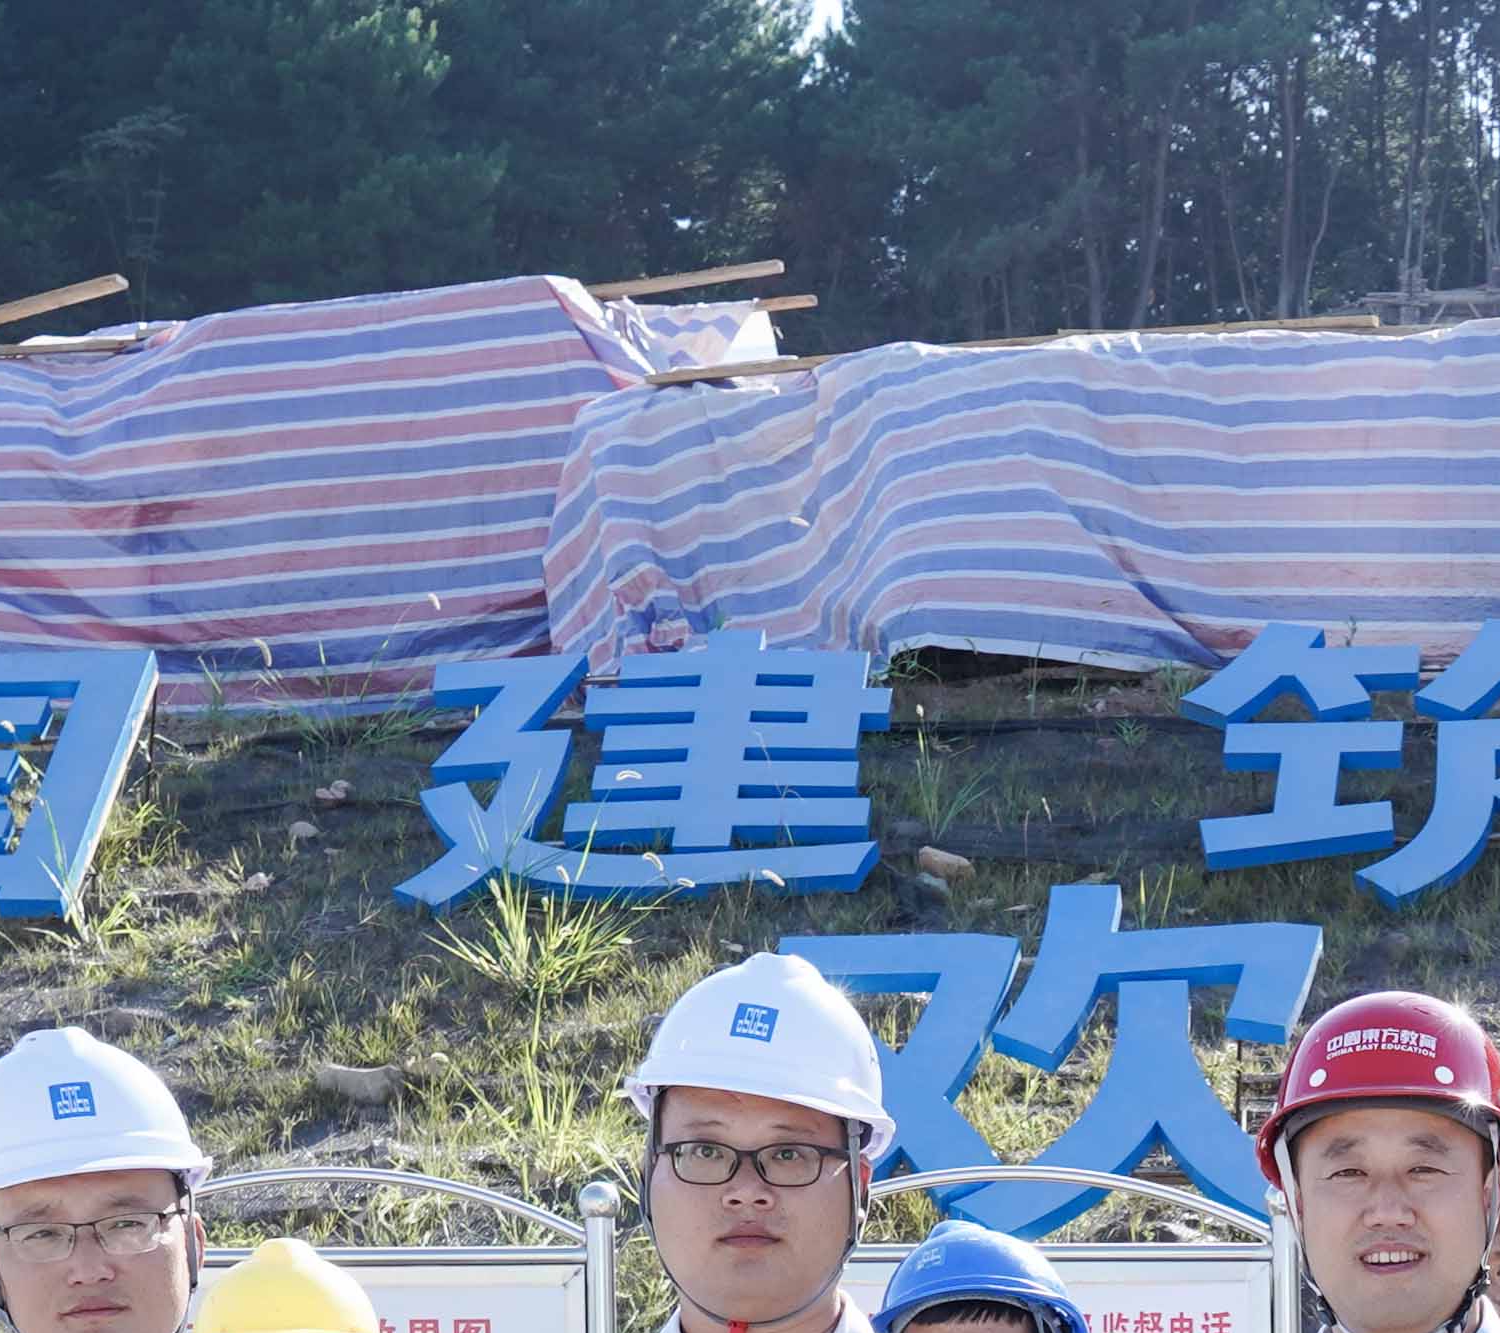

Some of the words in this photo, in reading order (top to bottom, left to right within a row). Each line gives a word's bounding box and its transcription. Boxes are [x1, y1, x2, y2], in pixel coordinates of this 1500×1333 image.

[1326, 1045, 1354, 1061] CHINA
[1356, 1042, 1378, 1051] EAST
[1381, 1042, 1436, 1058] EDUCATION
